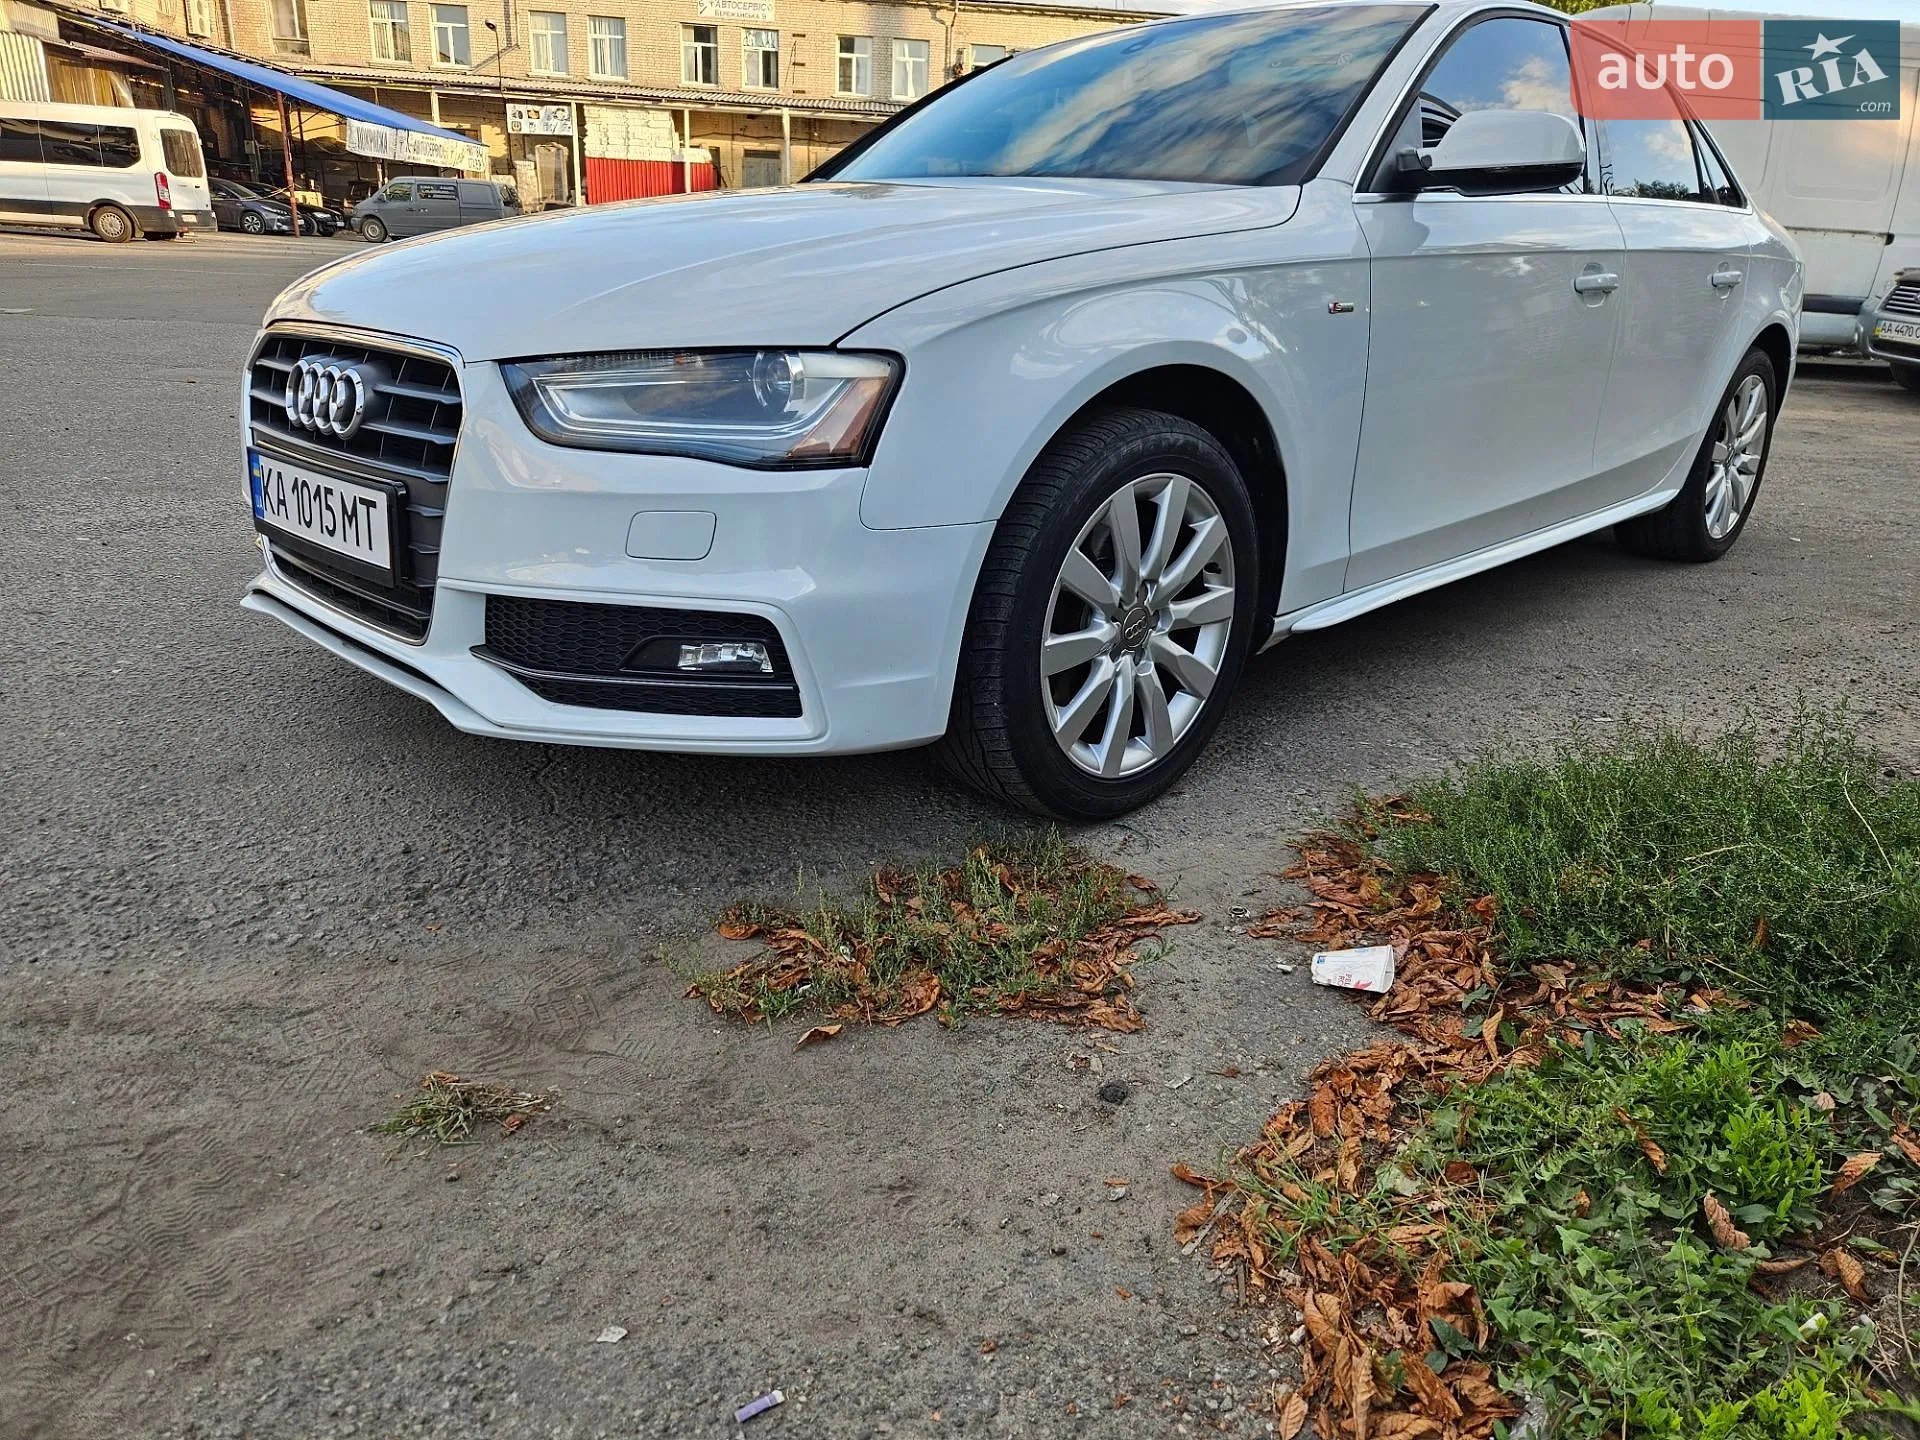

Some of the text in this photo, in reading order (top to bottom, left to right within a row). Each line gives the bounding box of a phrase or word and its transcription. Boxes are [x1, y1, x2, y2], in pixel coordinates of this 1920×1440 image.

[1881, 322, 1893, 334] AA
[1894, 324, 1914, 337] 4470
[261, 464, 377, 551] KA 1015 MT
